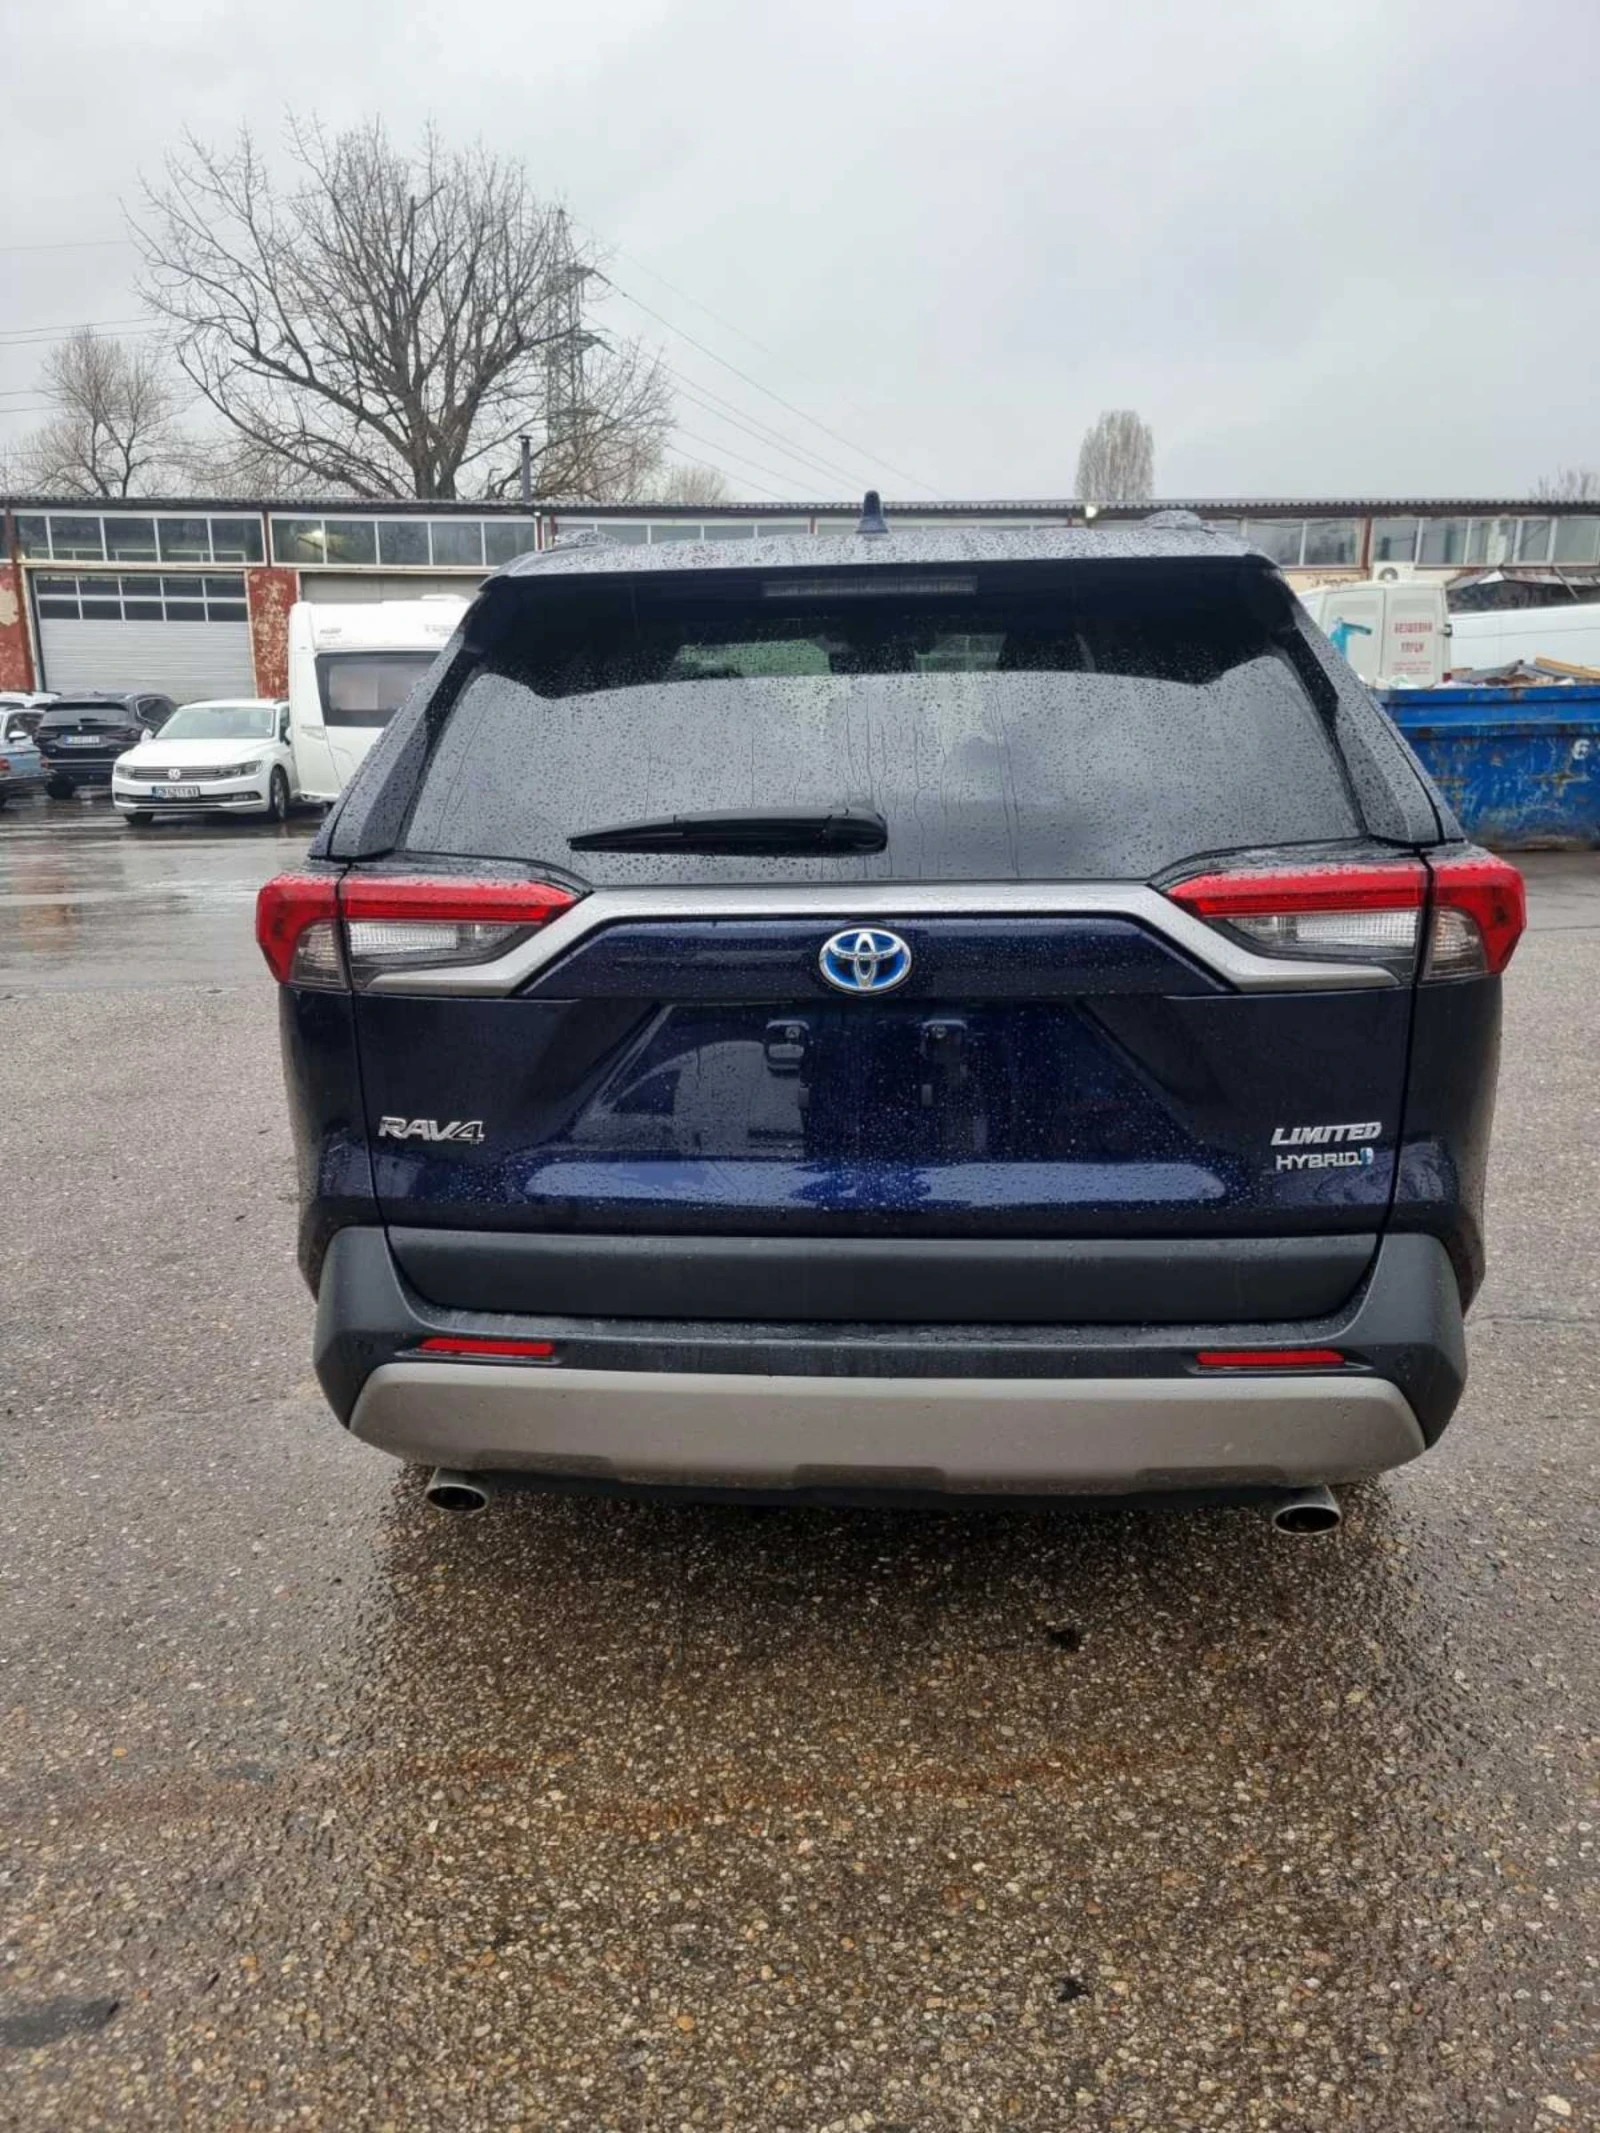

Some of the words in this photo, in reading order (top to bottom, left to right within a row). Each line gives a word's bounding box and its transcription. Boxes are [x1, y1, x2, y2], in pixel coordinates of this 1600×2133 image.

[378, 1116, 485, 1144] RAV4
[1271, 1122, 1382, 1146] LIMITED
[1277, 1151, 1362, 1171] HYBRID
